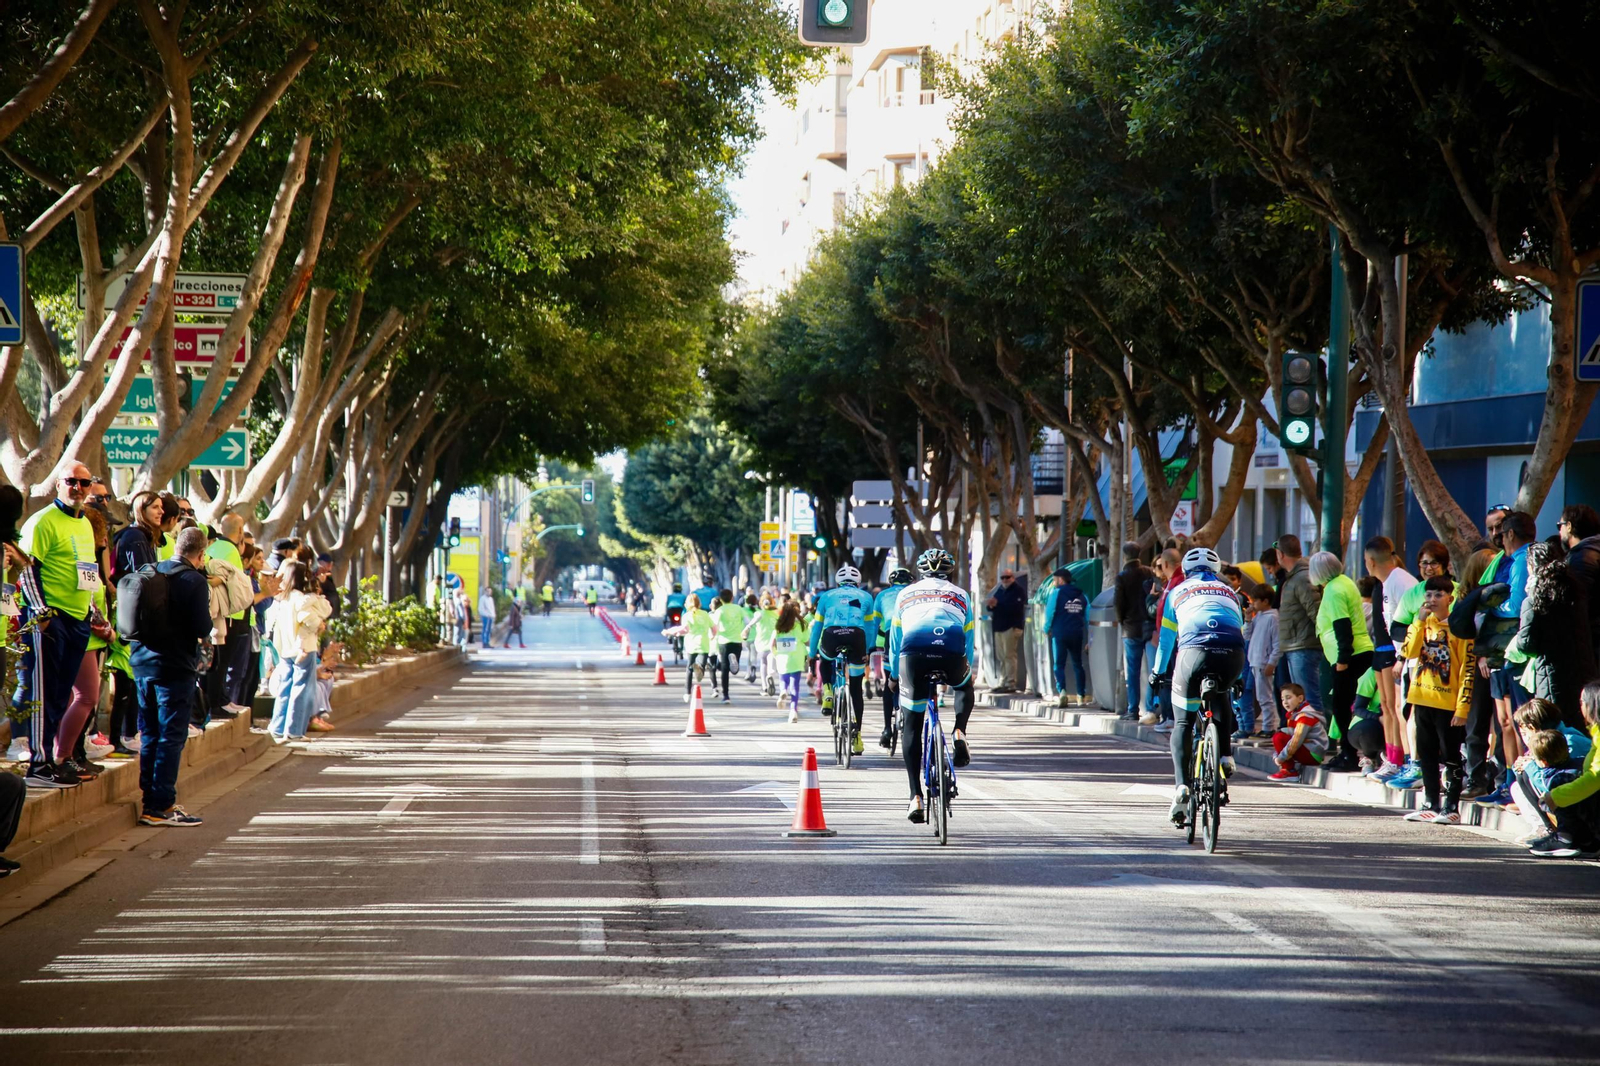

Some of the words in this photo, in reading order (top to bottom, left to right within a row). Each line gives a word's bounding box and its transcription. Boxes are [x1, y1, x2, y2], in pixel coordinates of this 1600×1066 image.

[173, 279, 242, 292] irecciones
[107, 448, 148, 460] chena
[82, 570, 96, 582] 196
[1432, 685, 1452, 693] ZONE
